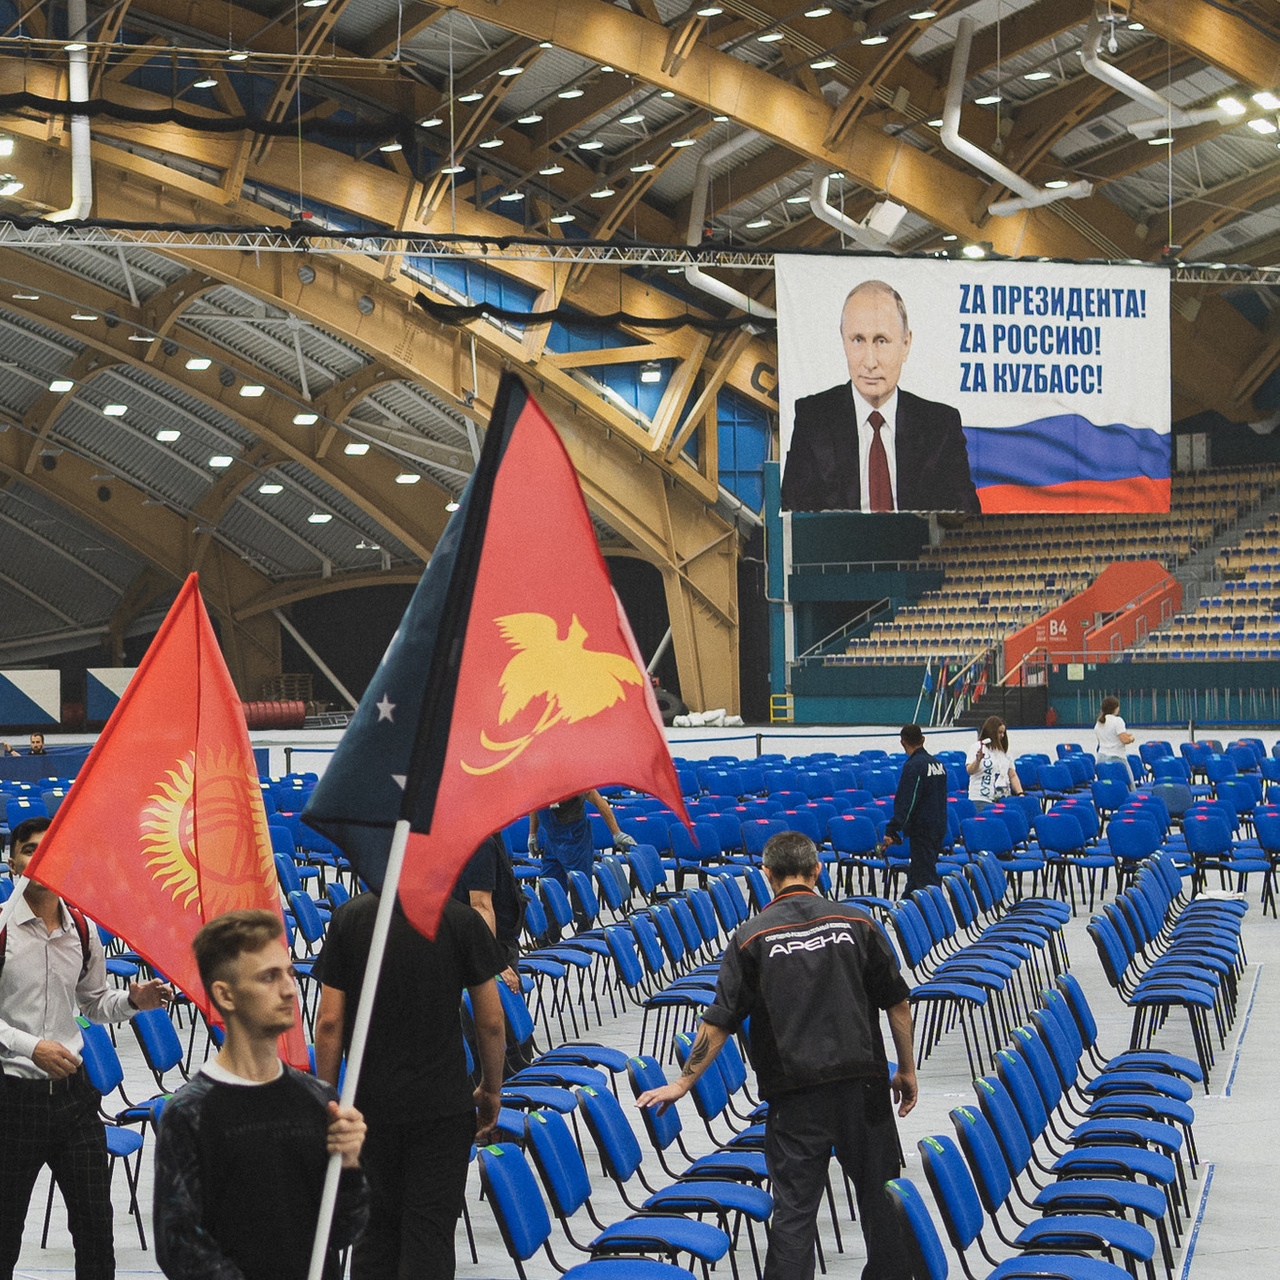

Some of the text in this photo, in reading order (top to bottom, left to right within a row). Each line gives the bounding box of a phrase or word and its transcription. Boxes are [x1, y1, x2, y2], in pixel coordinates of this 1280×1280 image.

[993, 286, 1147, 321] ПРЕЗИДЕНТА!
[994, 325, 1101, 355] РОССИЮ!
[994, 364, 1103, 394] КУZБАСС!
[768, 932, 855, 958] АРЕНА
